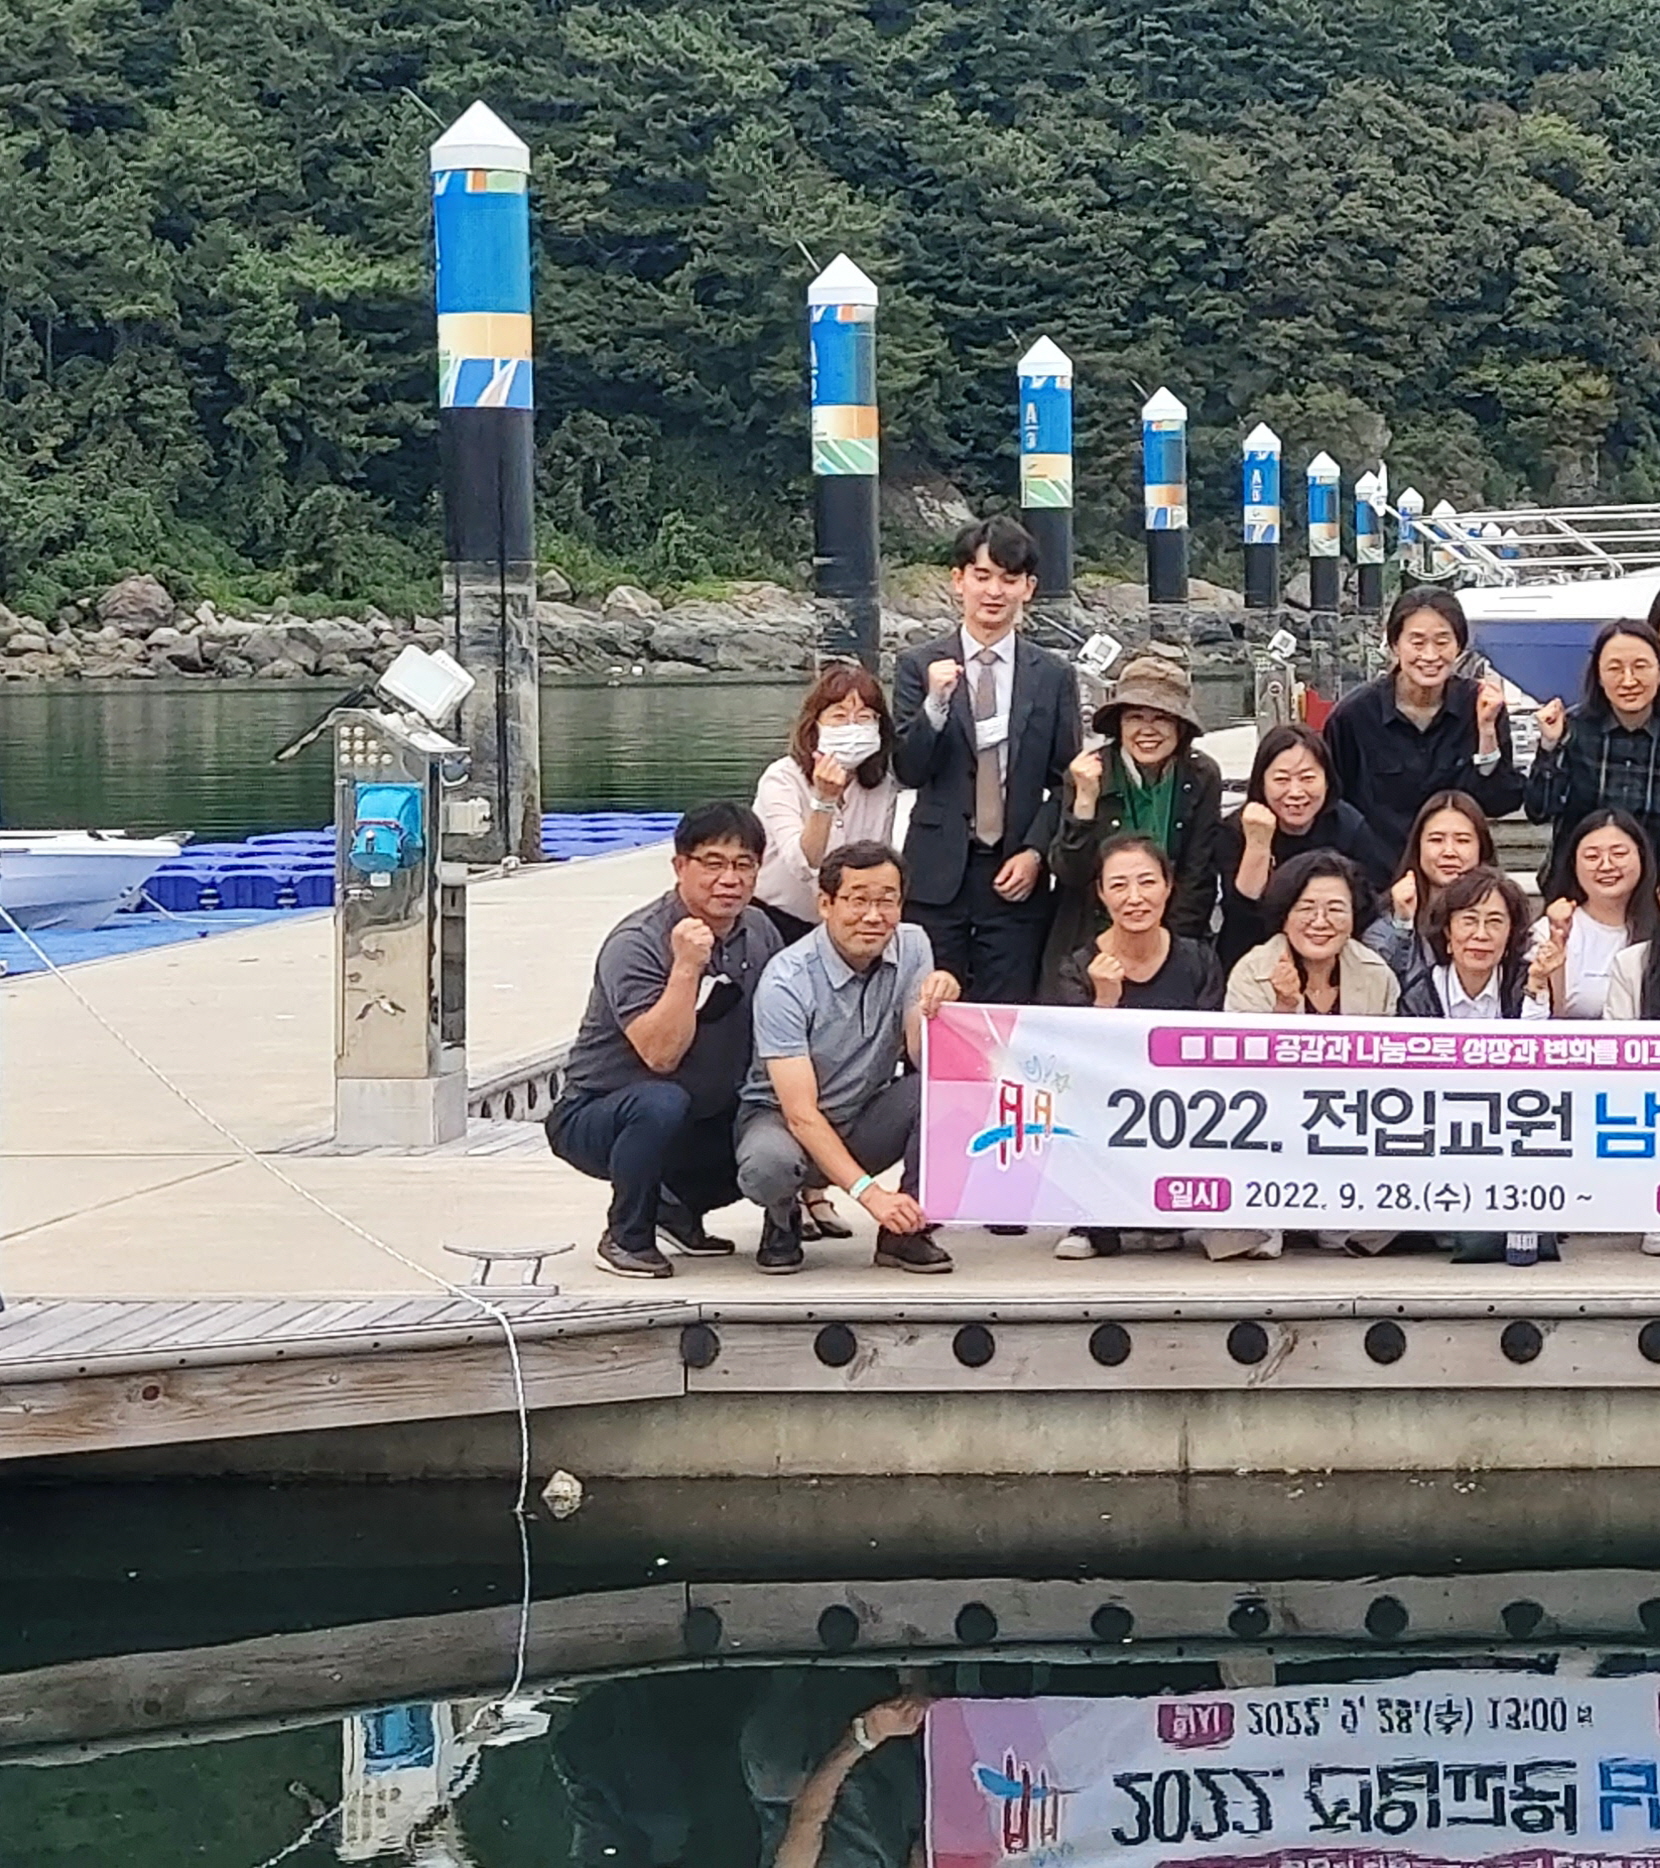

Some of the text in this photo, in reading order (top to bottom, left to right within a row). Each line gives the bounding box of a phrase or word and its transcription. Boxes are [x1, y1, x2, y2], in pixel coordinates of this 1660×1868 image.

[1273, 1034, 1351, 1063] 공감과
[1356, 1035, 1457, 1064] 나눔으로
[1462, 1037, 1538, 1065] 성장과
[1543, 1039, 1619, 1066] 변화를
[1106, 1088, 1284, 1154] 2022.
[1301, 1087, 1574, 1158] 전입교원
[1167, 1180, 1219, 1210] 일시
[1245, 1181, 1328, 1211] 2022.
[1338, 1182, 1366, 1211] 9.
[1375, 1181, 1472, 1213] 28.(수)
[1485, 1183, 1566, 1212] 13:00
